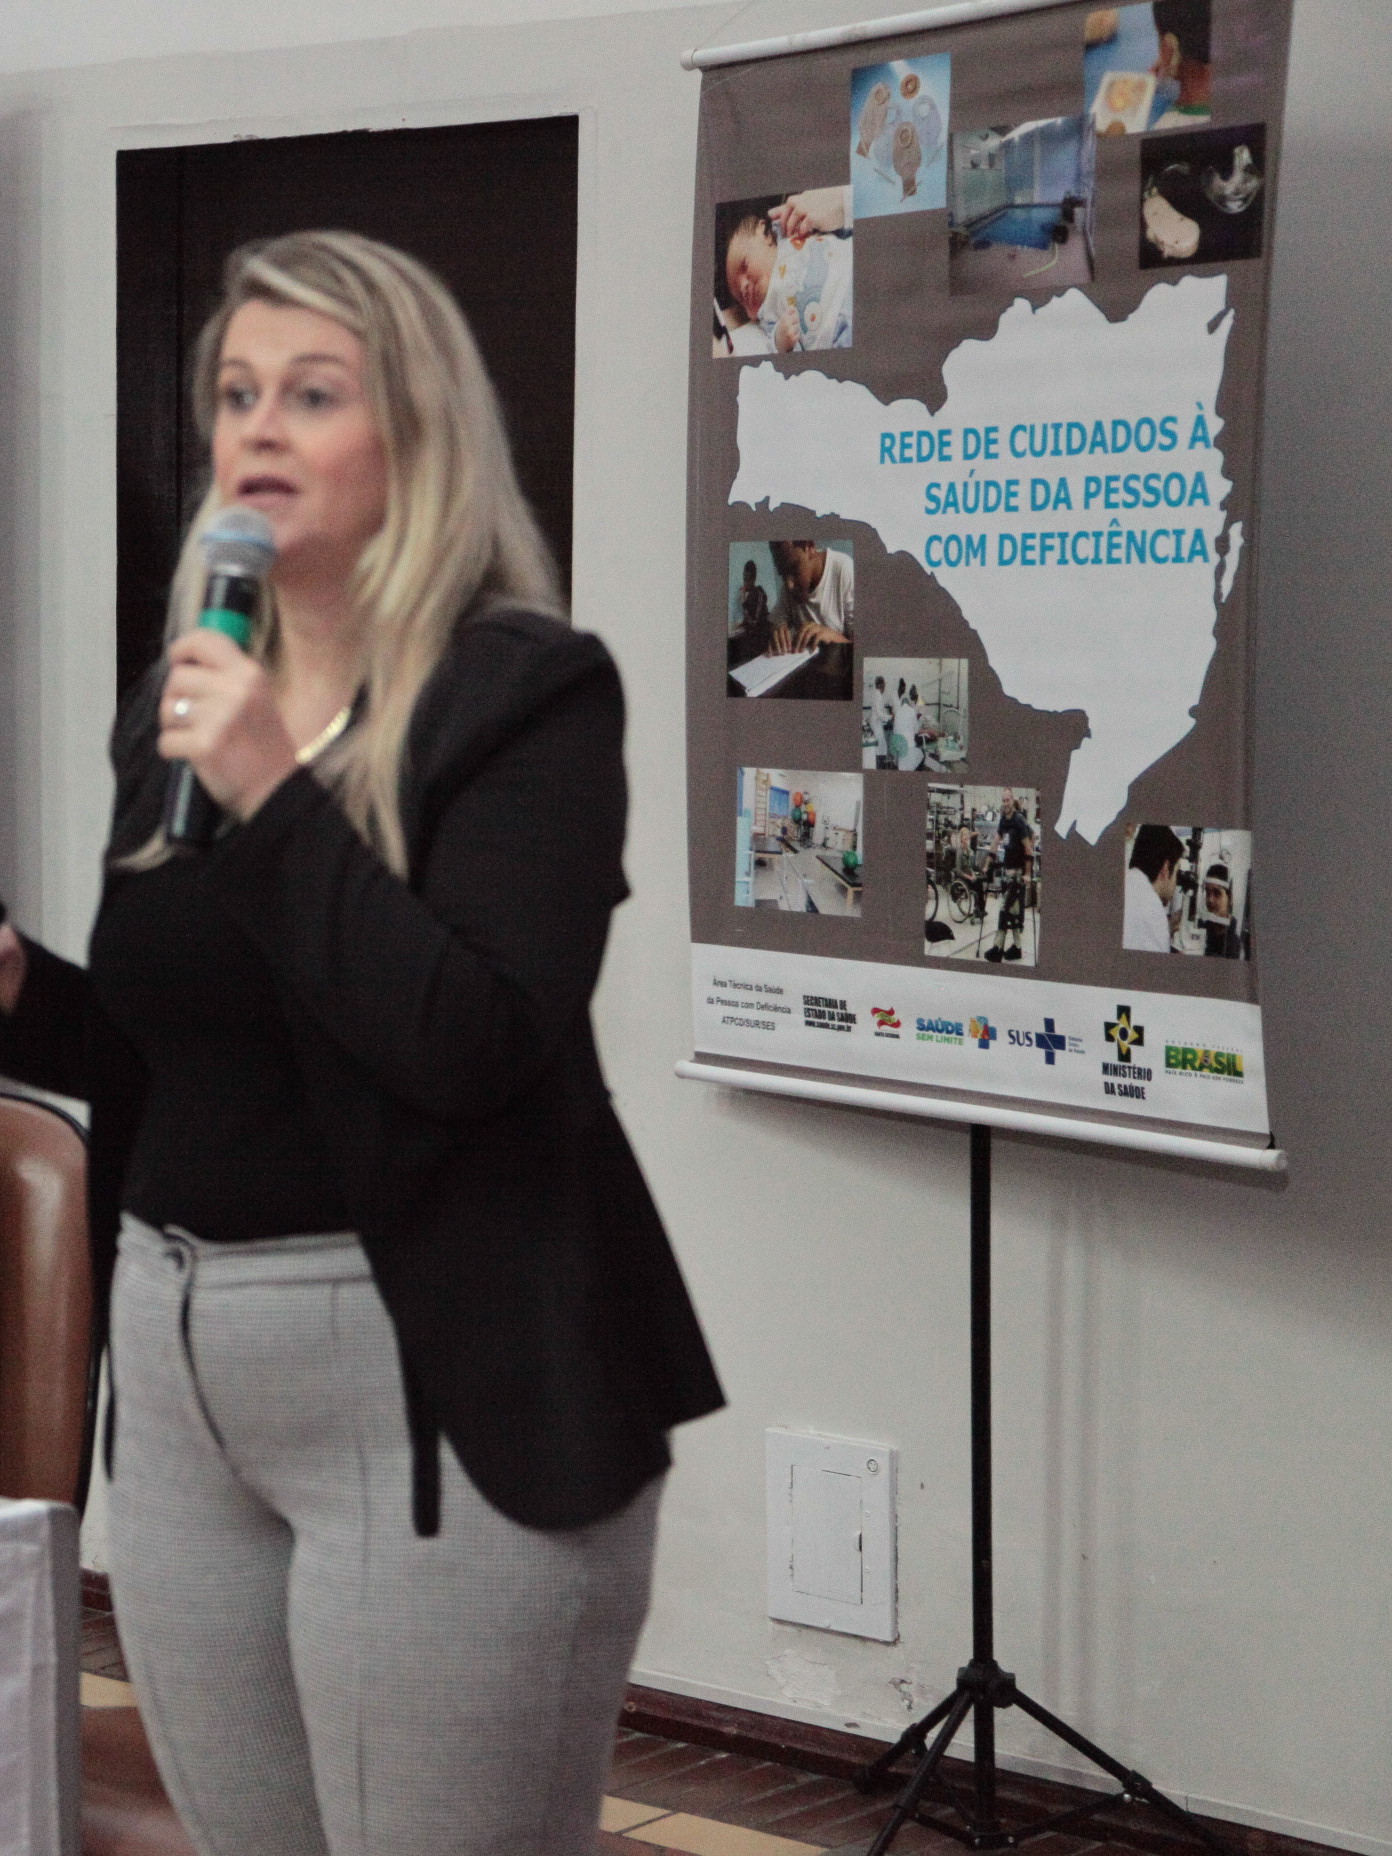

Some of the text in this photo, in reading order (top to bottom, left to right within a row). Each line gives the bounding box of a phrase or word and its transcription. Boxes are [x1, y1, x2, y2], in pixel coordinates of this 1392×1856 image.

[879, 401, 1212, 465] REDE DE CUIDADOS À
[924, 469, 1212, 515] SAÚDE DA PESSOA
[925, 517, 1211, 568] COM DEFICIÊNCIA
[764, 984, 784, 995] Saúde
[716, 996, 739, 1008] Pessoa
[741, 1001, 755, 1009] com
[756, 1001, 792, 1014] Deficiência
[803, 1007, 827, 1020] ESTADO
[916, 1017, 964, 1036] SAÚDE
[916, 1032, 965, 1046] SEM LIMITE
[1008, 1029, 1033, 1047] SUS
[1165, 1045, 1244, 1078] BRASIL
[1102, 1062, 1153, 1082] MINISTÉRIO
[1104, 1081, 1146, 1100] DA SAÚDE
